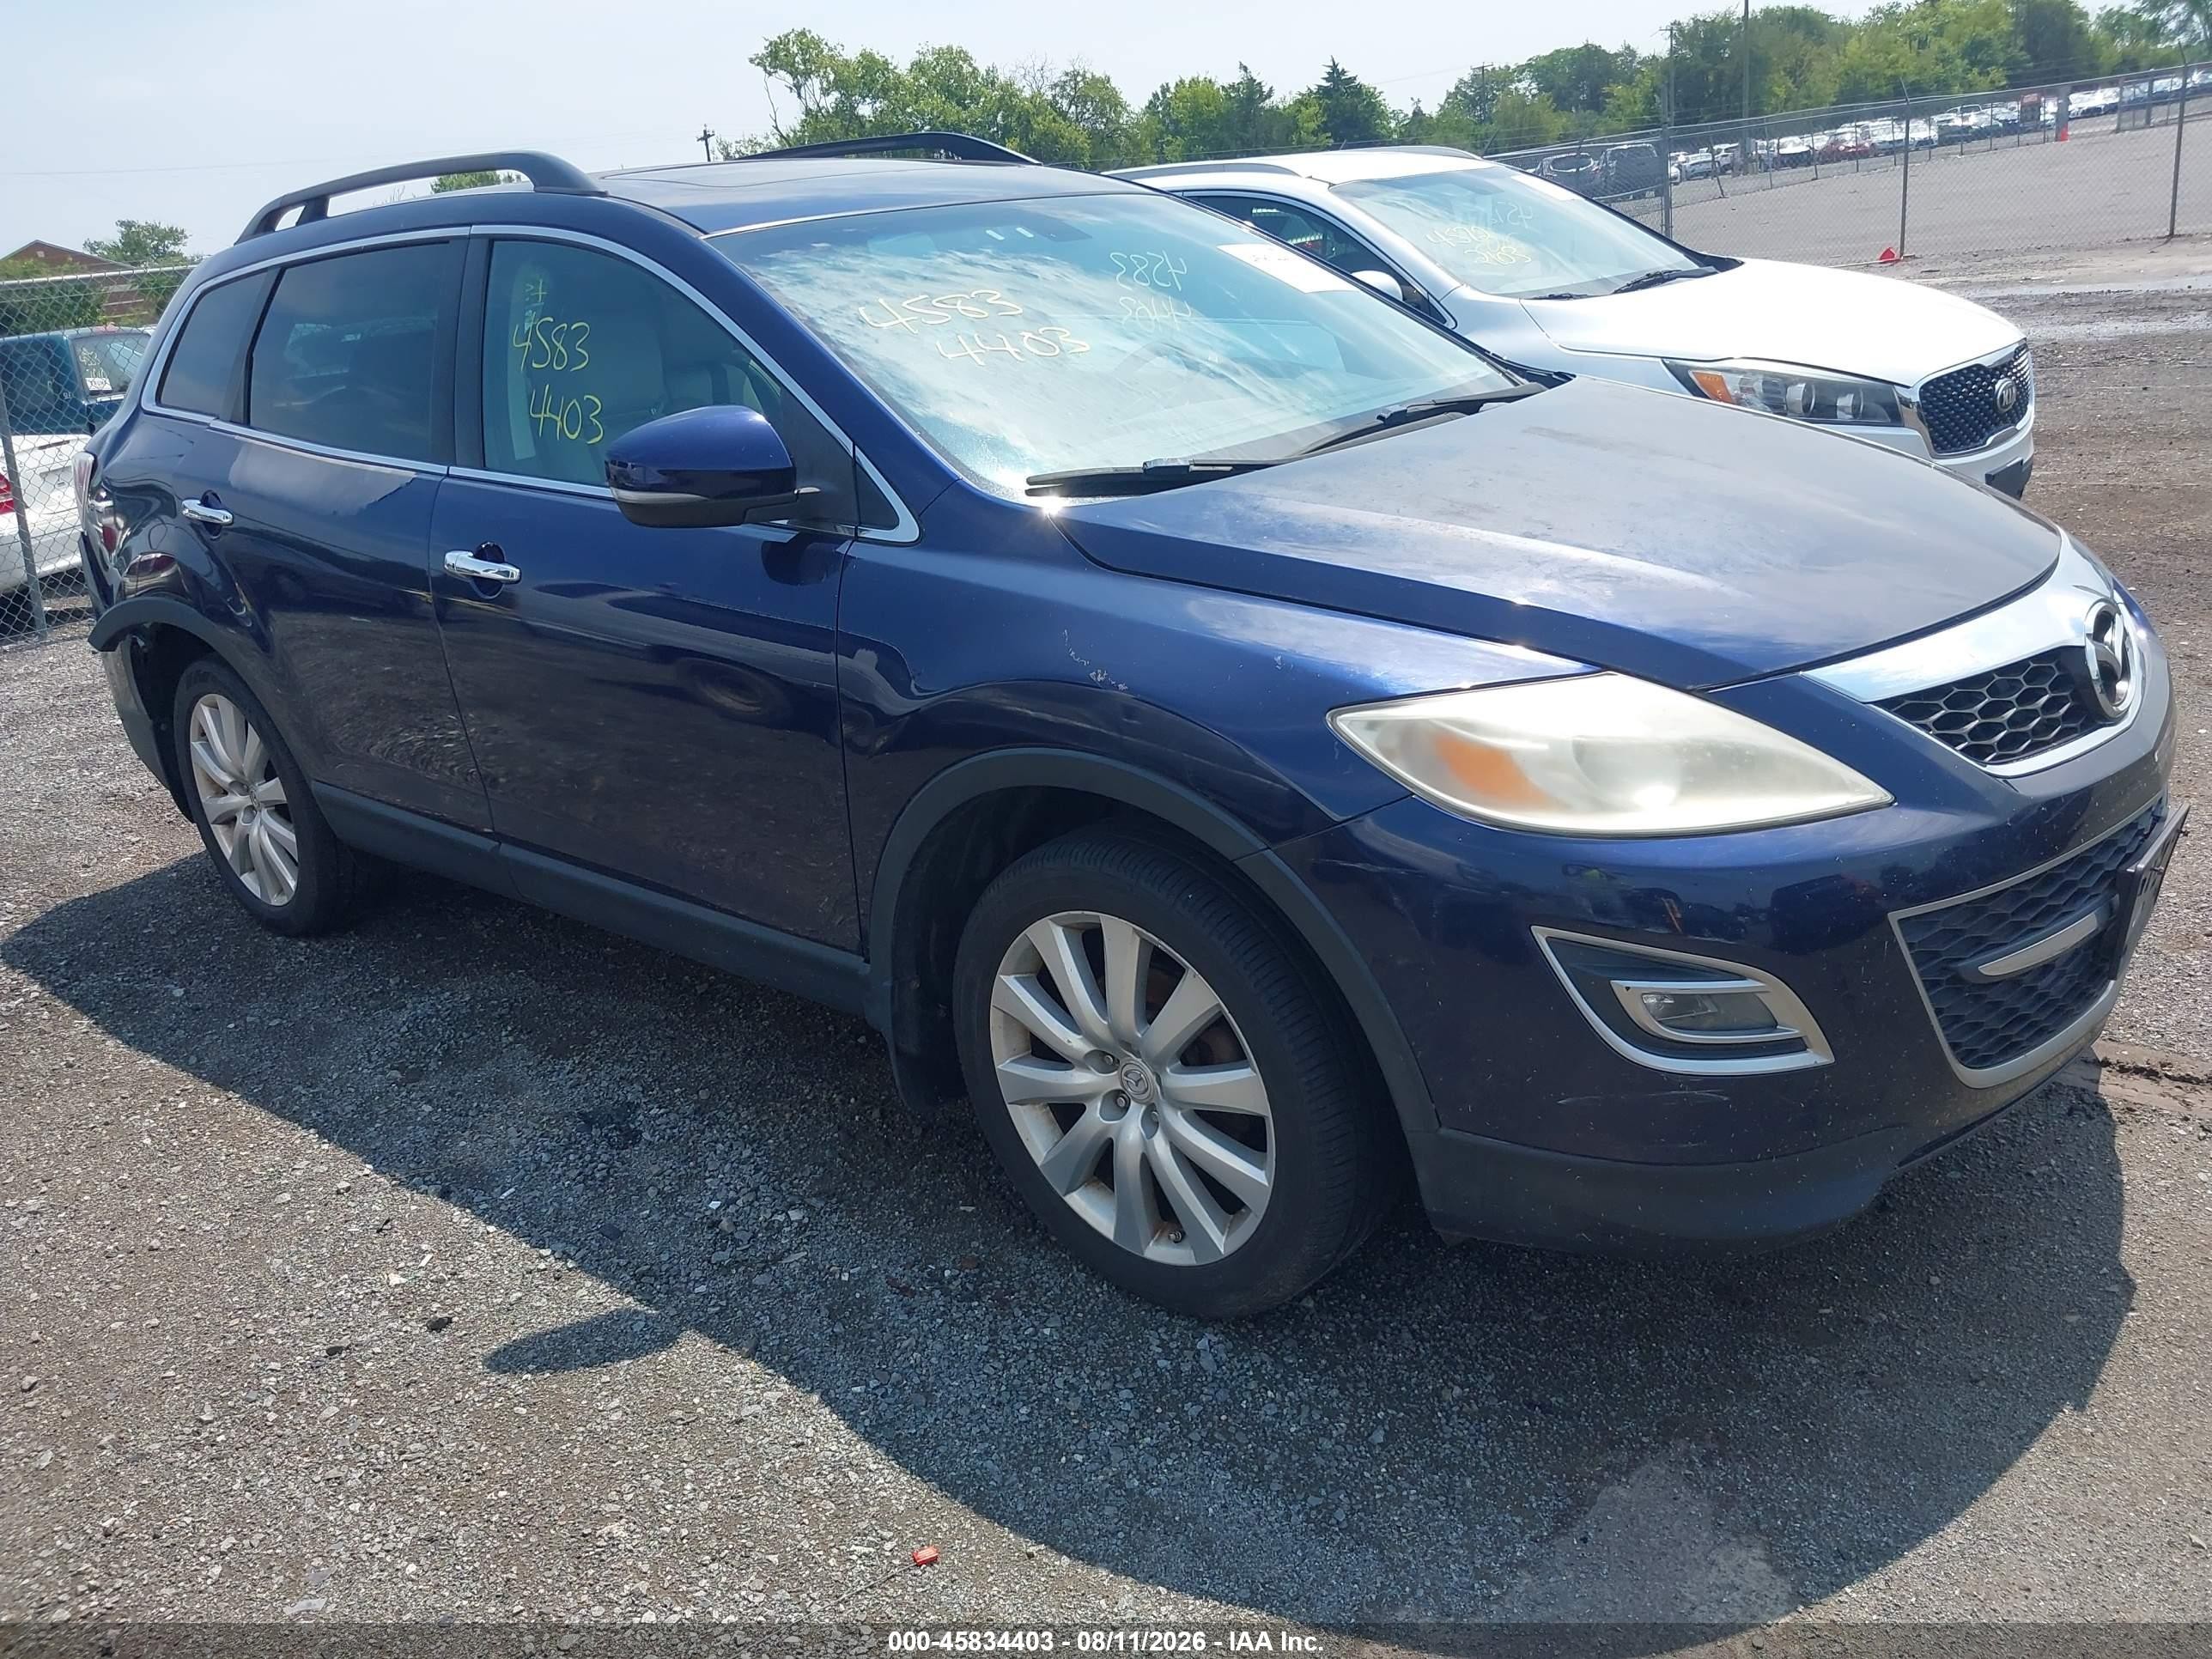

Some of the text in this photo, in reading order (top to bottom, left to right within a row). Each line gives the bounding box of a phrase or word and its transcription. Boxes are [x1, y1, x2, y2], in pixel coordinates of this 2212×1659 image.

[859, 289, 1024, 334] 4583
[513, 312, 591, 372] 4583
[935, 326, 1091, 367] 4403
[529, 384, 604, 445] 4403
